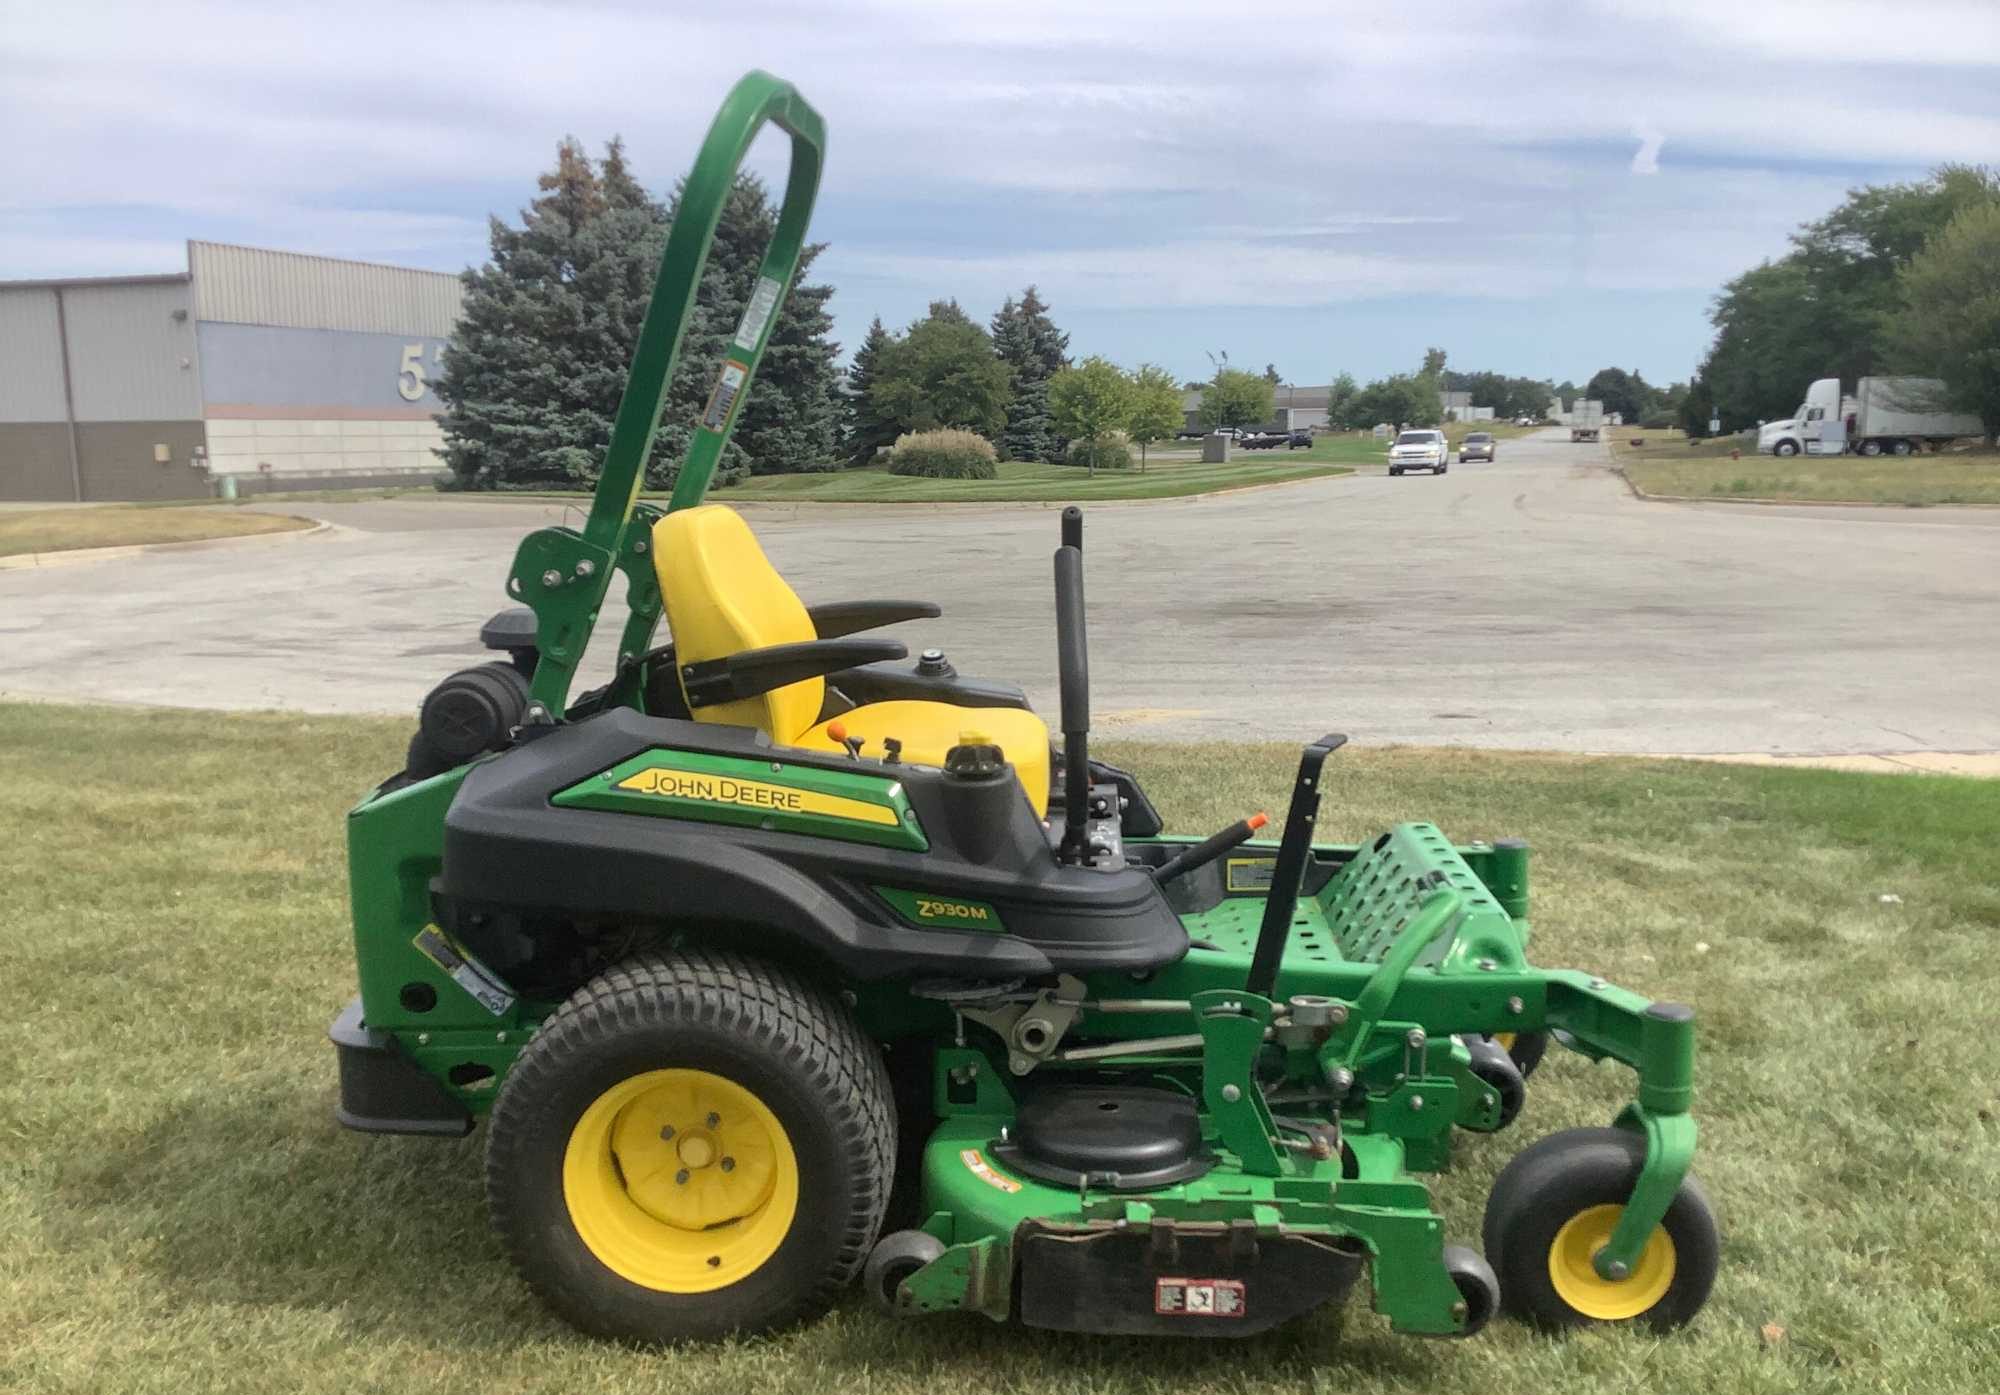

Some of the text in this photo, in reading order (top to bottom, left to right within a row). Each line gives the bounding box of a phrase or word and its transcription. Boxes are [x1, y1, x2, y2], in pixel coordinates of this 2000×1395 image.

[398, 344, 441, 401] 5
[645, 772, 801, 809] JOHN DEERE
[916, 900, 988, 920] Z930M
